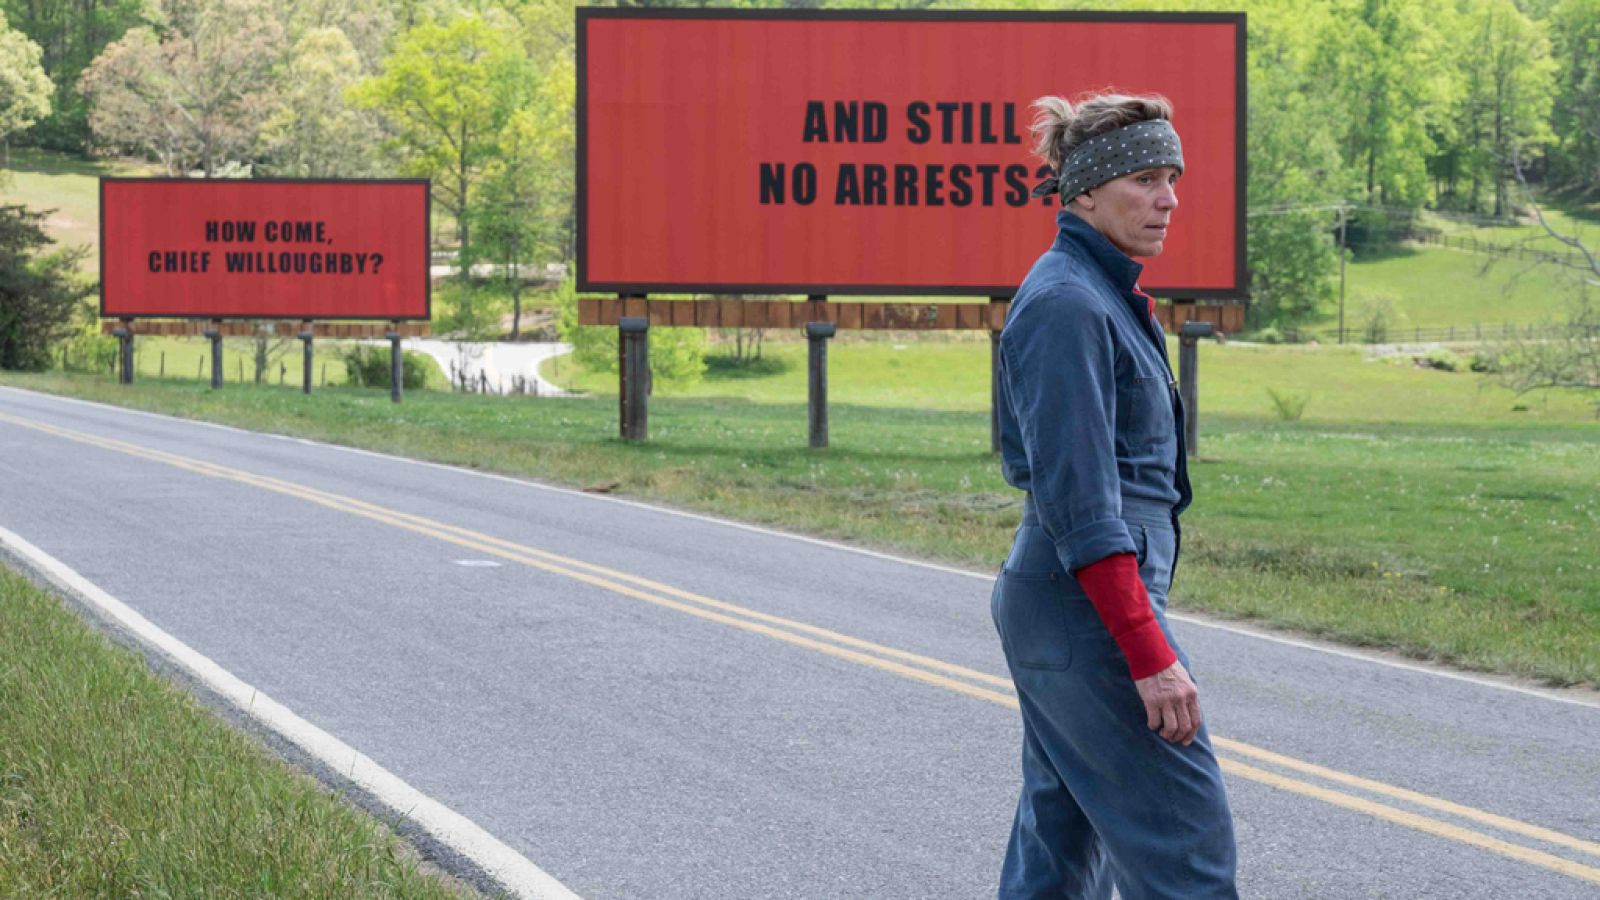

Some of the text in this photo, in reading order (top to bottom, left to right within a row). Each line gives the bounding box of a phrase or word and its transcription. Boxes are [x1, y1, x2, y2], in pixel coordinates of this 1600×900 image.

[803, 101, 1022, 144] AND STILL
[759, 162, 818, 206] NO
[205, 220, 334, 245] HOW COME,
[147, 250, 384, 275] CHIEF WILLOUGHBY?
